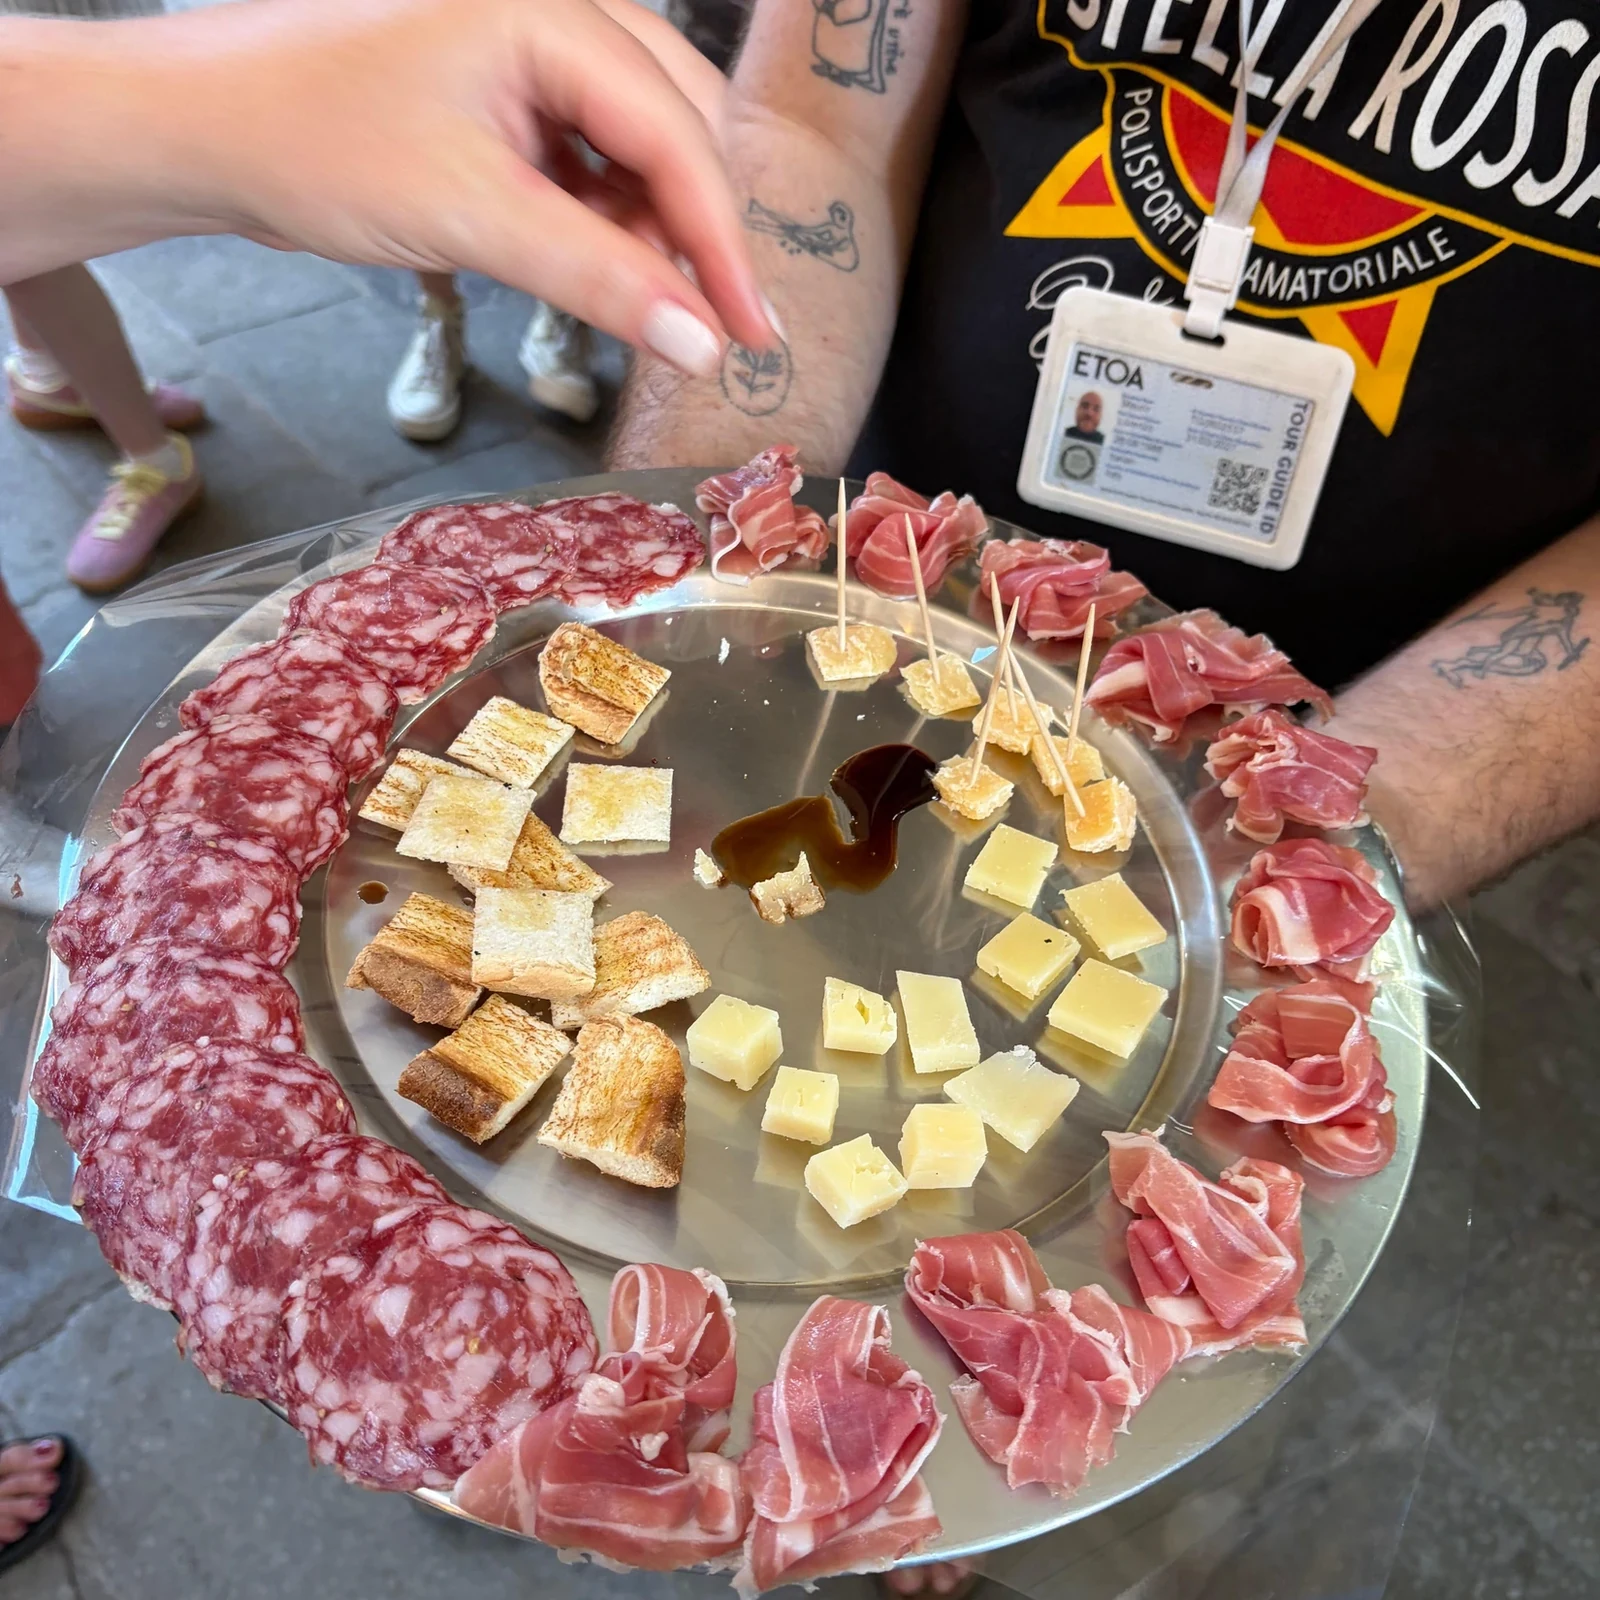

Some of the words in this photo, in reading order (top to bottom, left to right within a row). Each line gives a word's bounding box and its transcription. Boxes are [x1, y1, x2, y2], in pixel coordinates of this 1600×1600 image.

[1347, 0, 1600, 229] ROSS
[1120, 87, 1201, 257] POLISPORTI
[1241, 226, 1457, 302] AMATORIALE
[1073, 350, 1144, 391] ETOA
[1280, 401, 1309, 452] TOUR
[1264, 455, 1293, 513] GUIDE
[1259, 515, 1276, 535] ID
